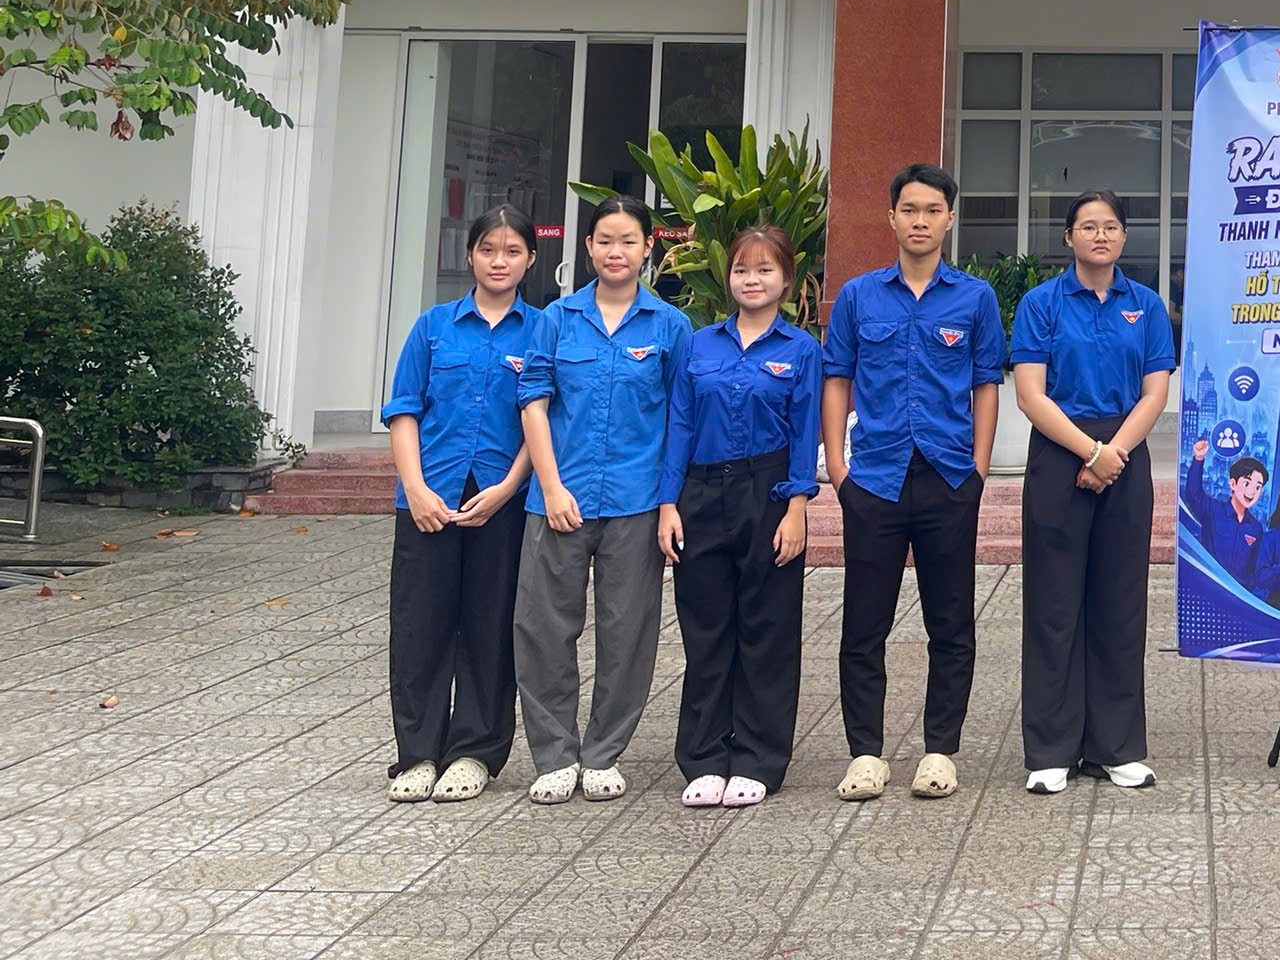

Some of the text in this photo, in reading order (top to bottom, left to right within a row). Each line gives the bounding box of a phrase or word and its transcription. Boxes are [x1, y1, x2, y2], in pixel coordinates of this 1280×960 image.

[537, 228, 560, 237] SANG
[1218, 220, 1269, 242] THANH
[1245, 269, 1269, 296] HỖ
